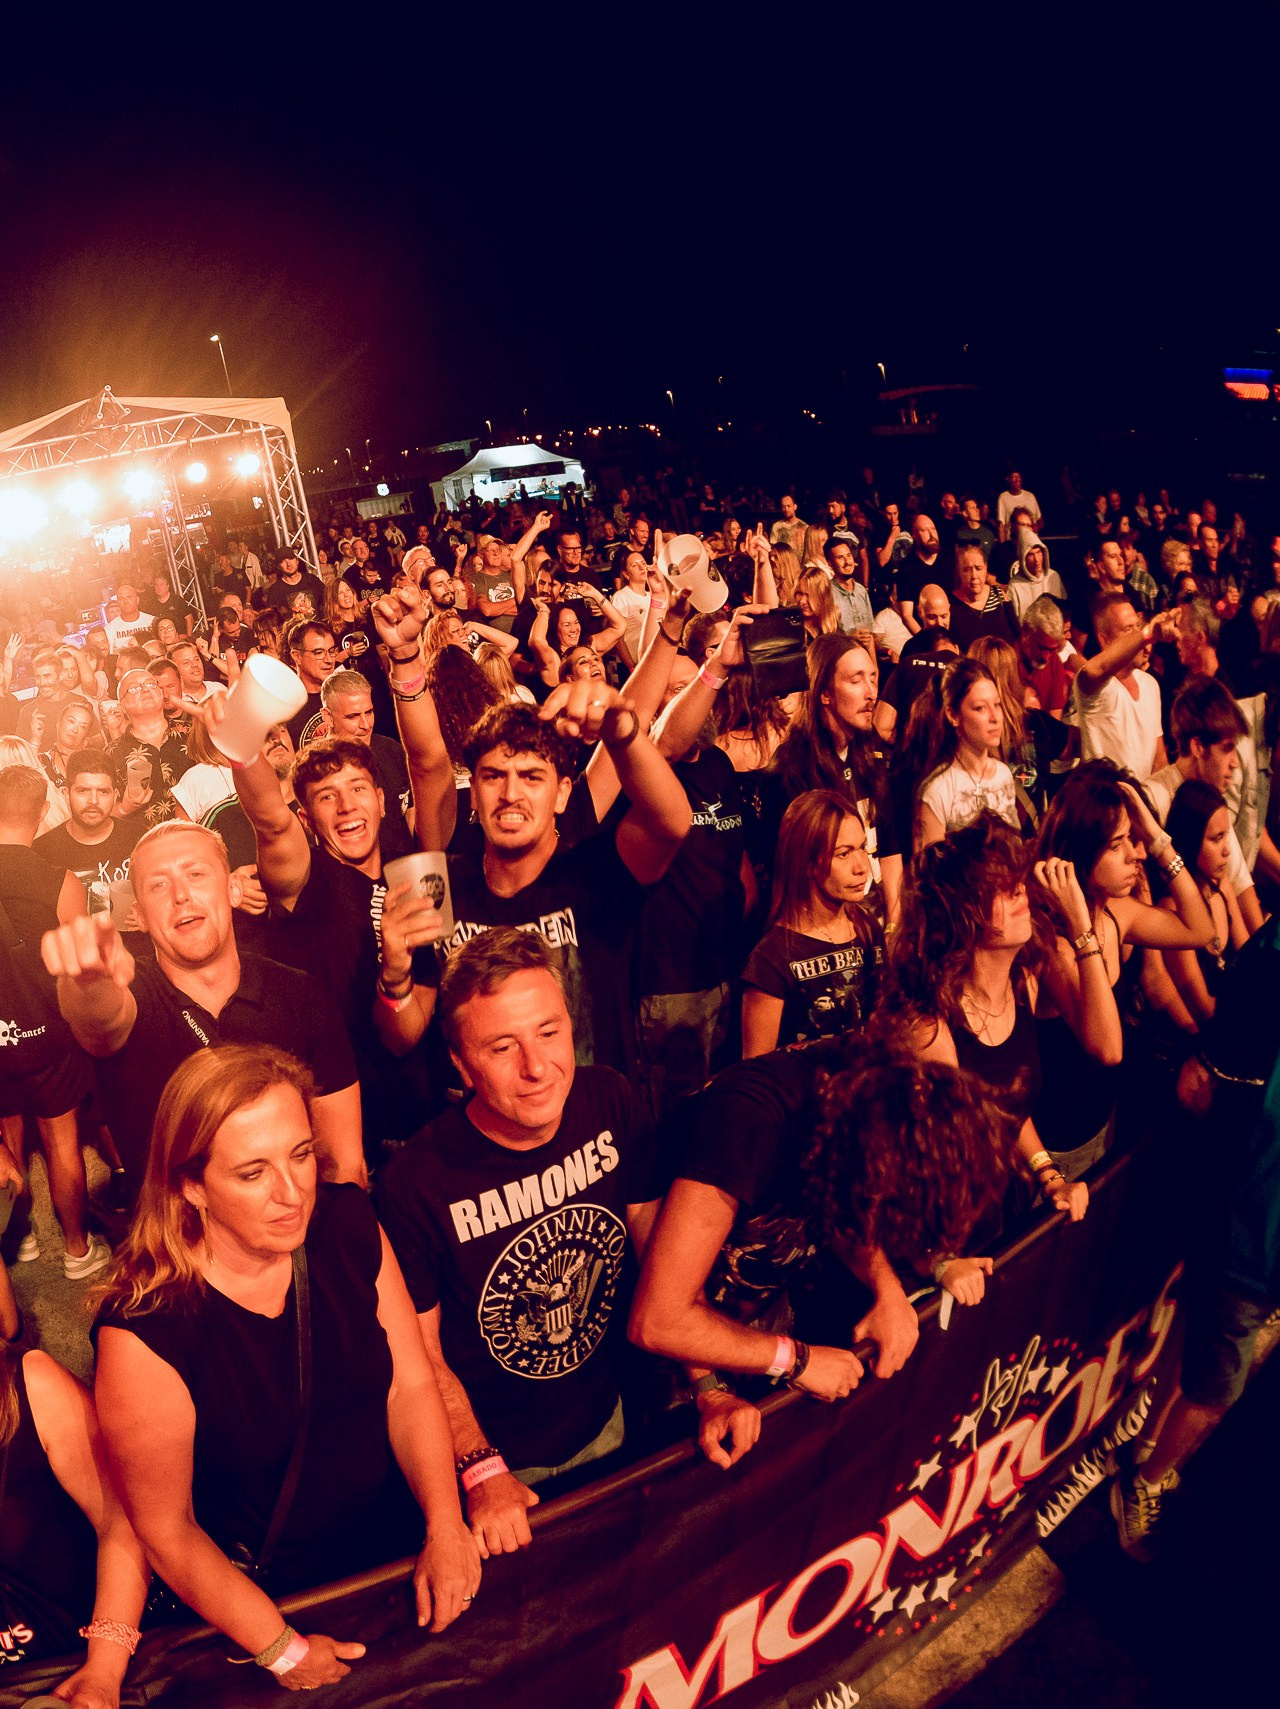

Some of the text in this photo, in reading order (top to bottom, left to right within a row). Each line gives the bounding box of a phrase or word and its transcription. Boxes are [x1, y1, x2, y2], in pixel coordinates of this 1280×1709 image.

[793, 956, 831, 979] THE
[13, 1025, 46, 1039] Cancer
[449, 1130, 620, 1244] RAMONES
[505, 1209, 602, 1274] JOHNNY
[483, 1285, 519, 1366] TOMMY
